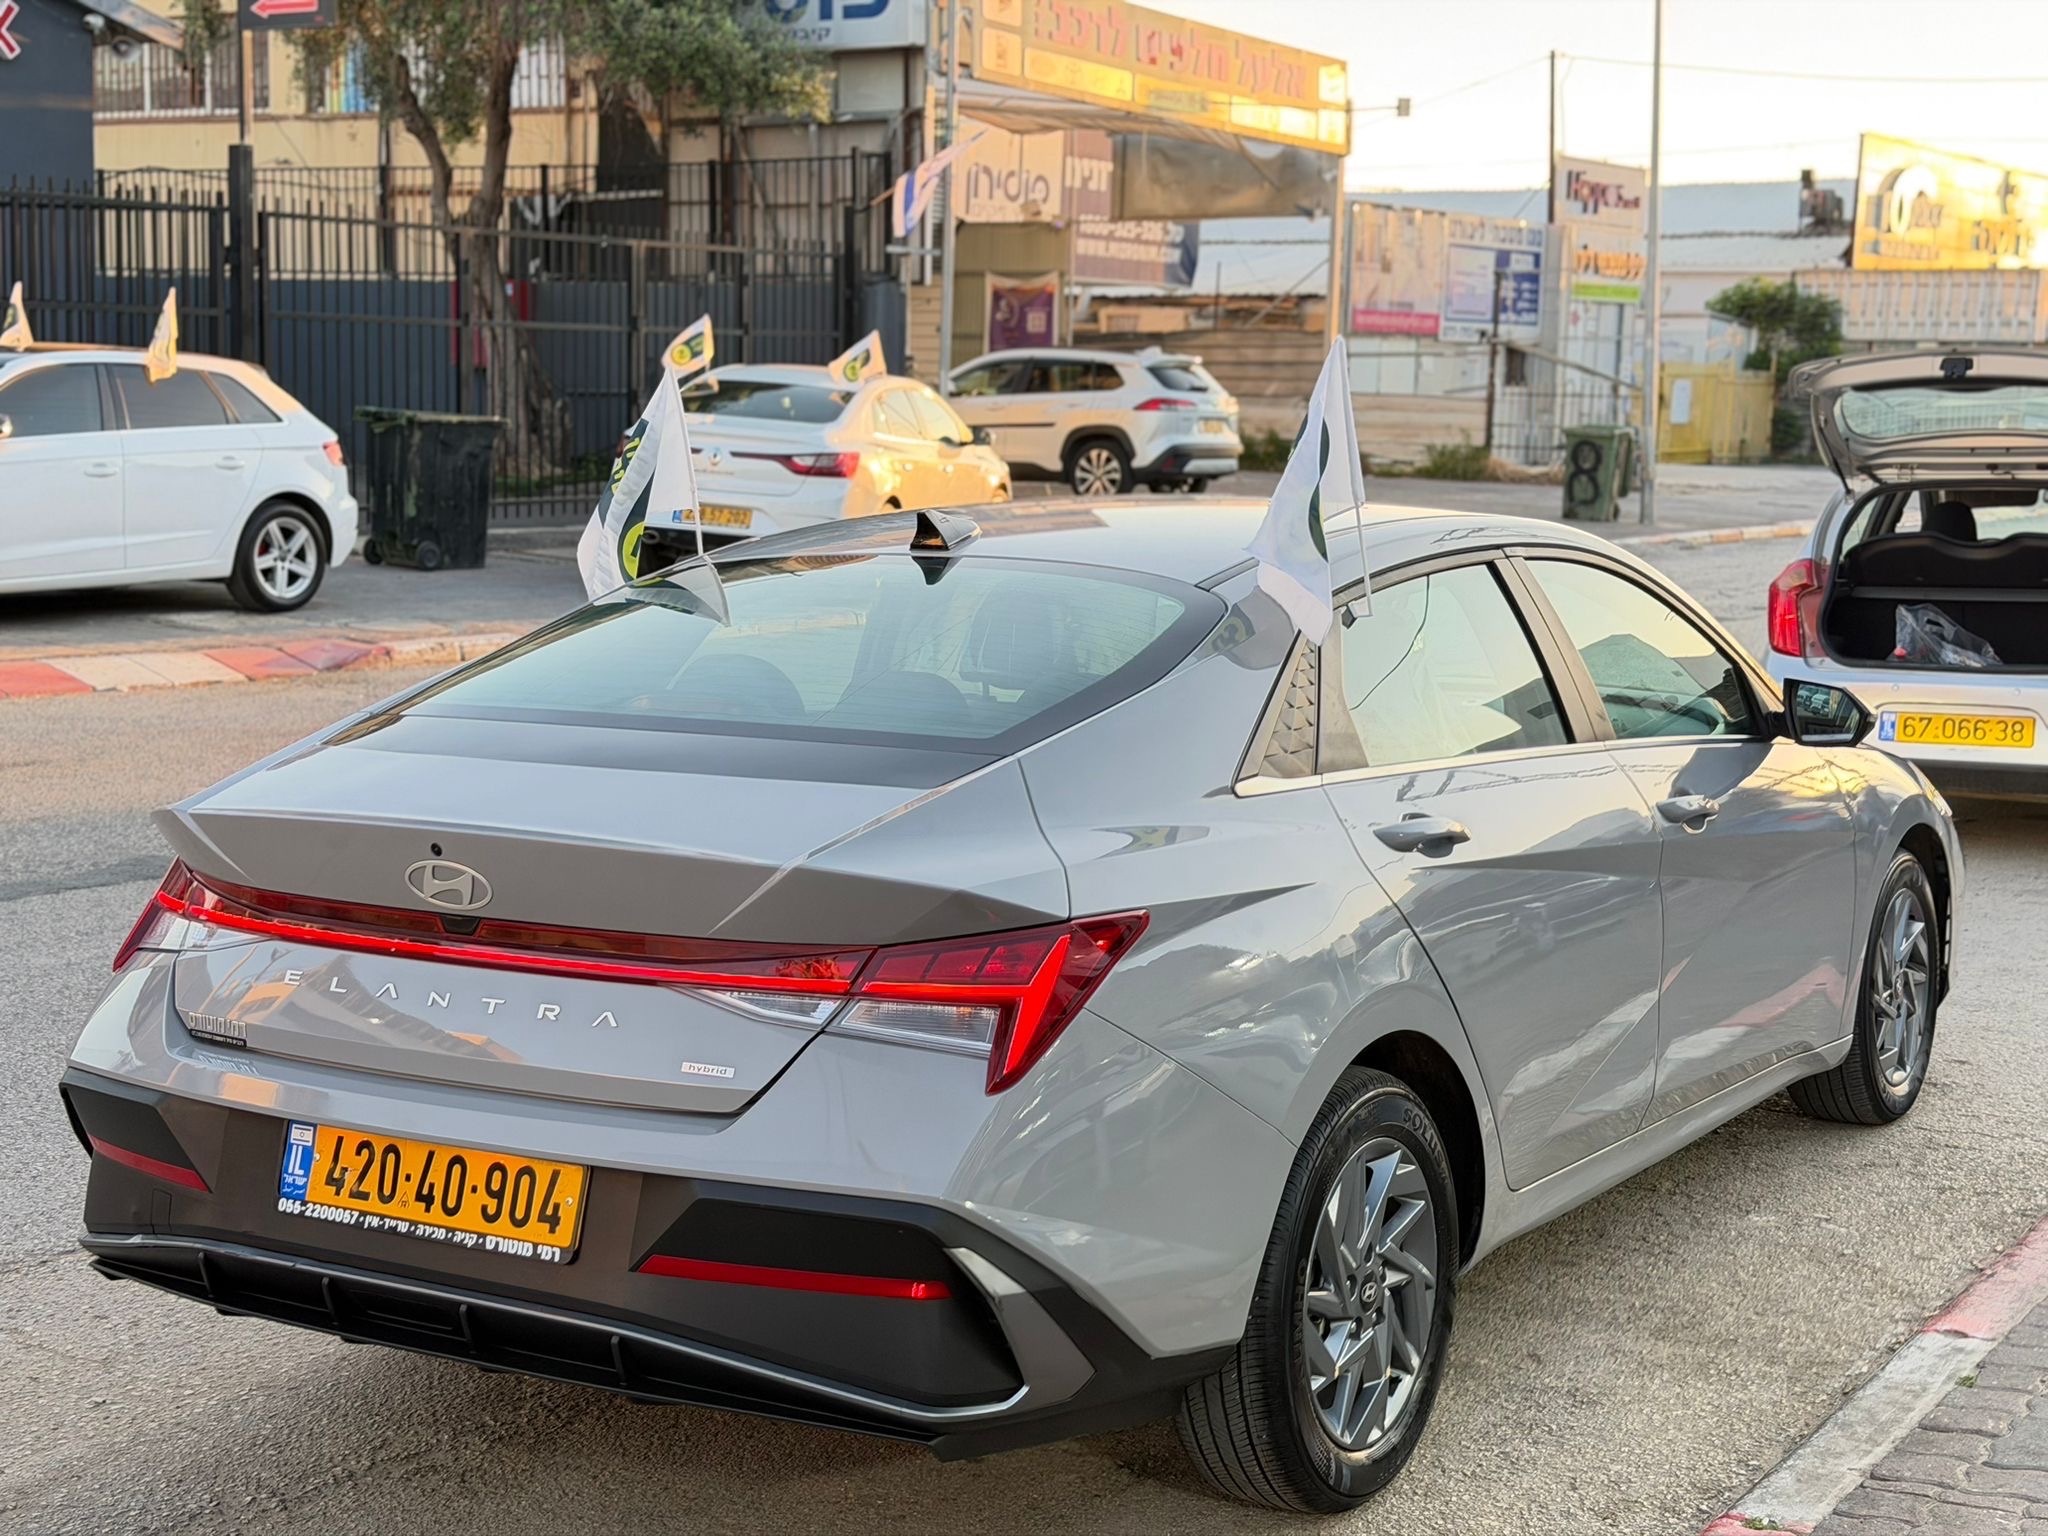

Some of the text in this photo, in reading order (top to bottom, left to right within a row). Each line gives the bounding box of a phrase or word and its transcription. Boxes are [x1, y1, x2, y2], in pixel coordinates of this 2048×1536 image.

[283, 969, 619, 1028] ELANTRA
[688, 1063, 728, 1076] hybrid
[287, 1144, 305, 1176] IL
[415, 1223, 447, 1240] מכירה
[453, 1230, 478, 1248] קניה
[485, 1235, 534, 1257] מוטורס
[537, 1246, 561, 1263] רמי
